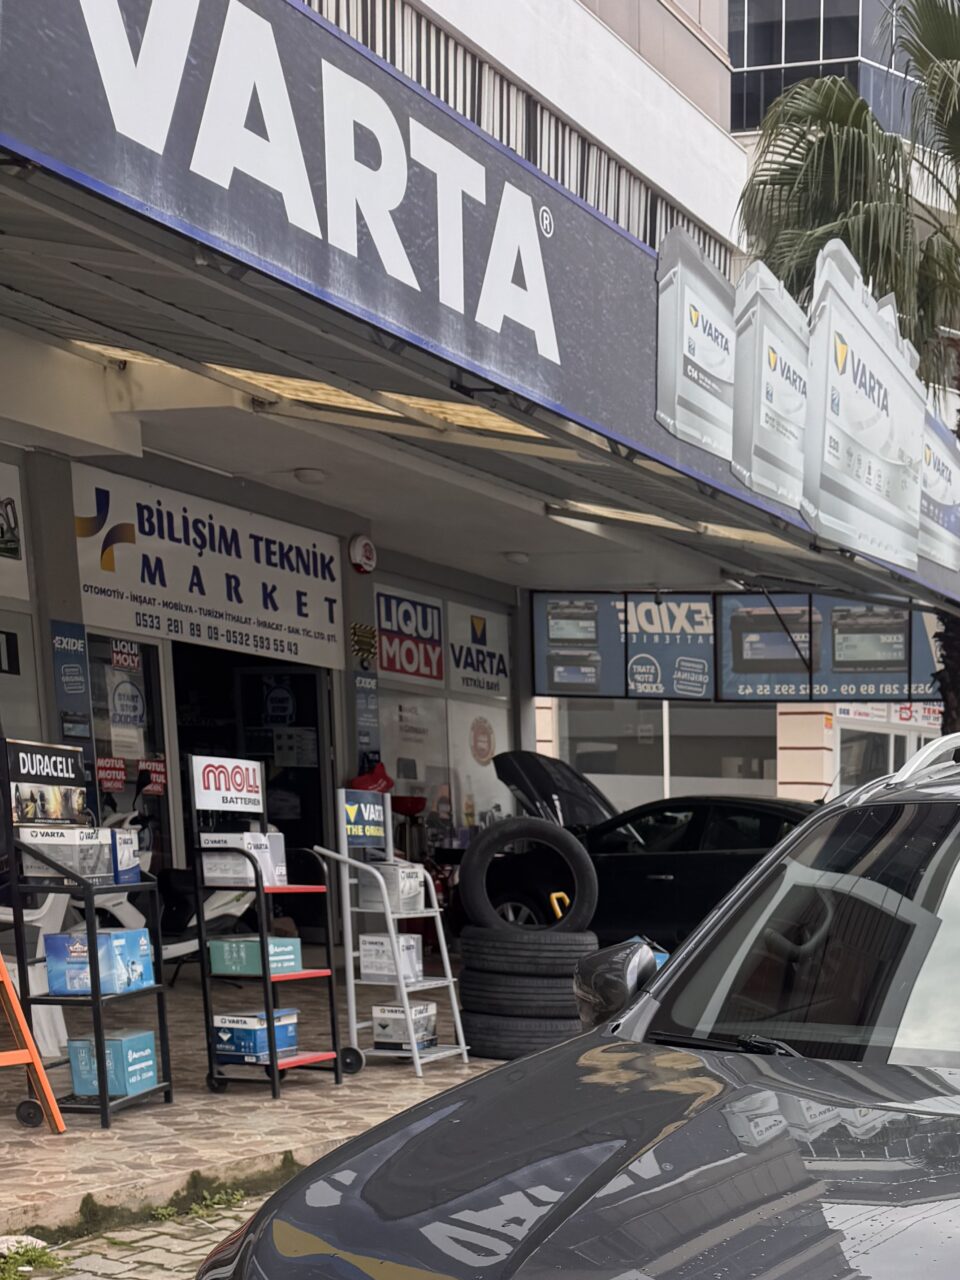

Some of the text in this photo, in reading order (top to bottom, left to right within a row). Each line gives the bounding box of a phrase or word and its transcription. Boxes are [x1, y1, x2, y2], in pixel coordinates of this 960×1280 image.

[701, 313, 730, 356] VARTA
[779, 356, 807, 399] VARTA
[851, 350, 889, 417] VARTA
[932, 453, 952, 486] VARTA
[136, 499, 336, 582] BİLİŞİM TEKNİK
[83, 583, 125, 600] OTOMOTİV
[130, 591, 157, 606] İNŞAAT
[162, 599, 193, 614] MOBİLYA
[198, 607, 224, 619] TURİZM
[224, 610, 252, 626] İTHALAT
[256, 618, 283, 632] İHRACAT
[288, 626, 301, 635] SAN.
[302, 628, 313, 638] TİC.
[314, 631, 326, 641] LTD.
[379, 596, 440, 641] LIQUI
[53, 636, 85, 652] EXIDE
[135, 611, 161, 630] 0533
[167, 618, 183, 634] 281
[190, 623, 201, 637] 89
[253, 636, 270, 651] 593
[273, 639, 285, 654] 55
[287, 641, 298, 656] 43
[112, 640, 138, 655] LIQUI
[113, 653, 140, 668] MOLY
[381, 636, 441, 676] MOLY
[451, 643, 508, 678] VARTA
[462, 677, 485, 691] YETKİLİ
[19, 752, 75, 778] DURACELL
[97, 758, 125, 768] MOTUL
[98, 769, 126, 779] MOTUL
[138, 760, 165, 772] MOTUL
[221, 795, 260, 806] BATTERIEN
[39, 830, 65, 838] VARTA
[346, 824, 364, 835] THE
